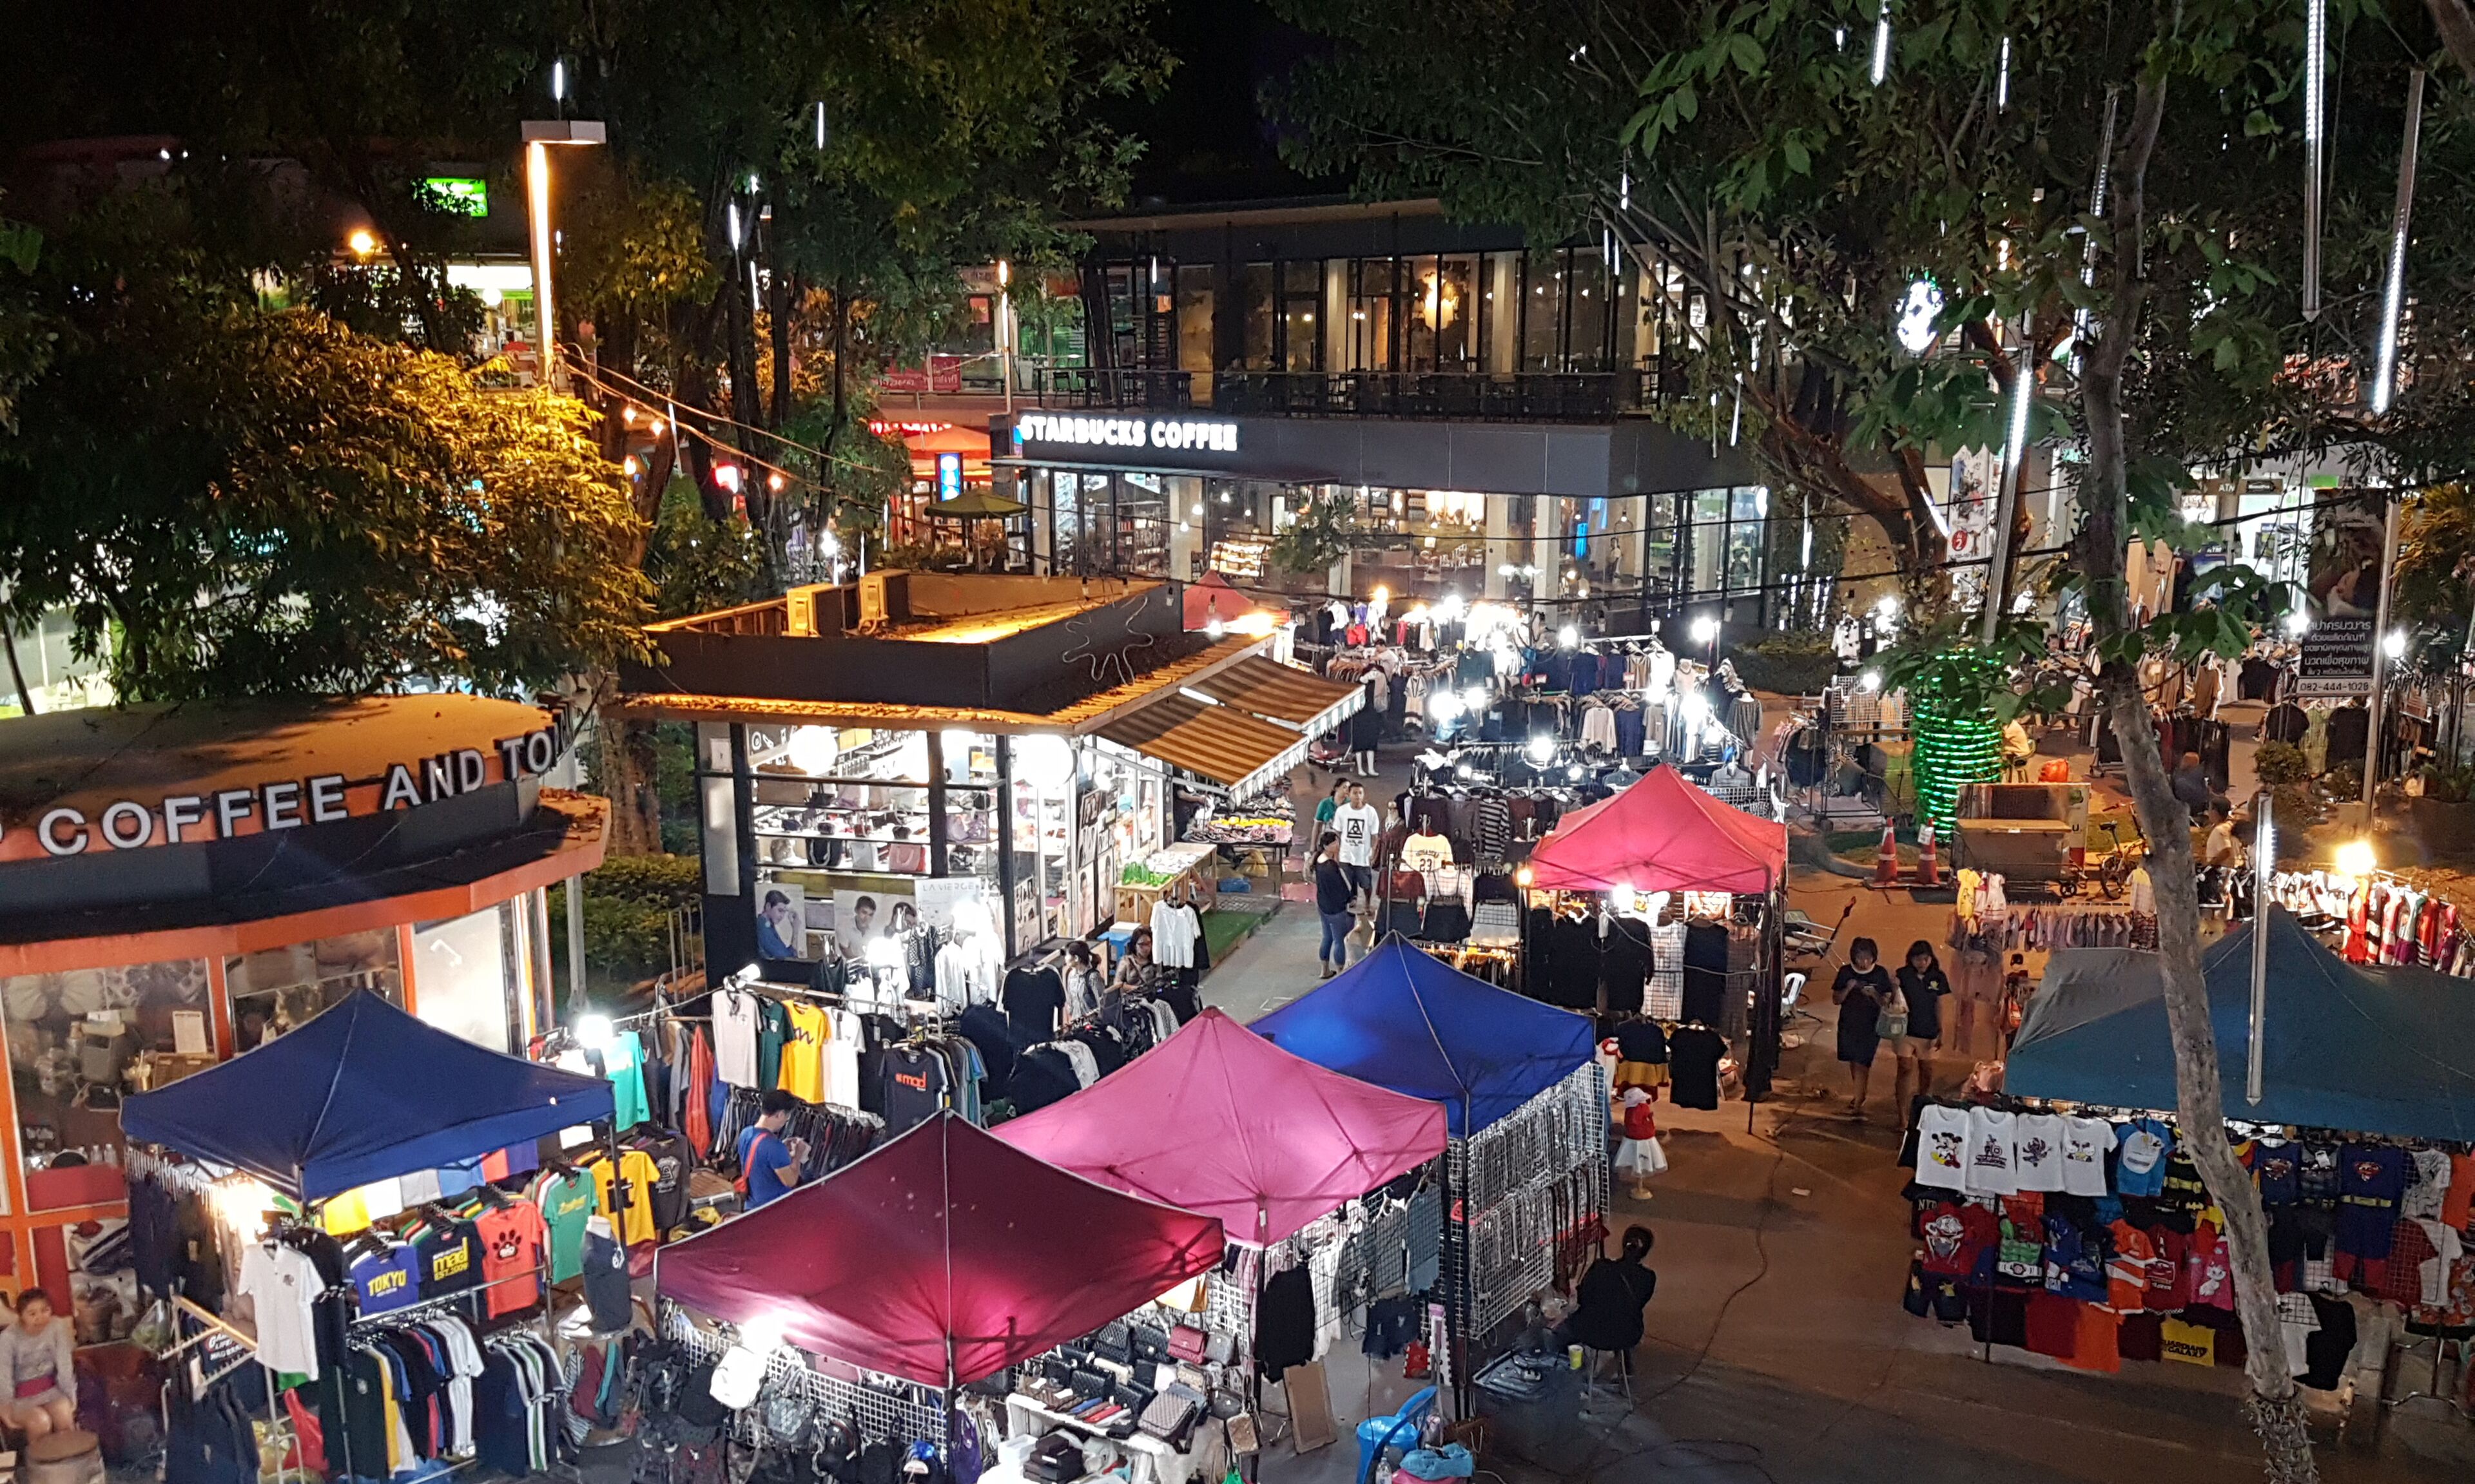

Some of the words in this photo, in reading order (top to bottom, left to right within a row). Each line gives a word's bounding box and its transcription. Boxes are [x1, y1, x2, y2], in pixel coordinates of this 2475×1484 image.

[1019, 414, 1146, 447] STARBUCKS
[1150, 421, 1238, 451] COFFEE
[38, 775, 349, 856] COFFEE
[384, 748, 485, 810] AND
[1419, 858, 1432, 872] 23
[433, 1237, 469, 1272] mad
[367, 1269, 407, 1297] TOKYO
